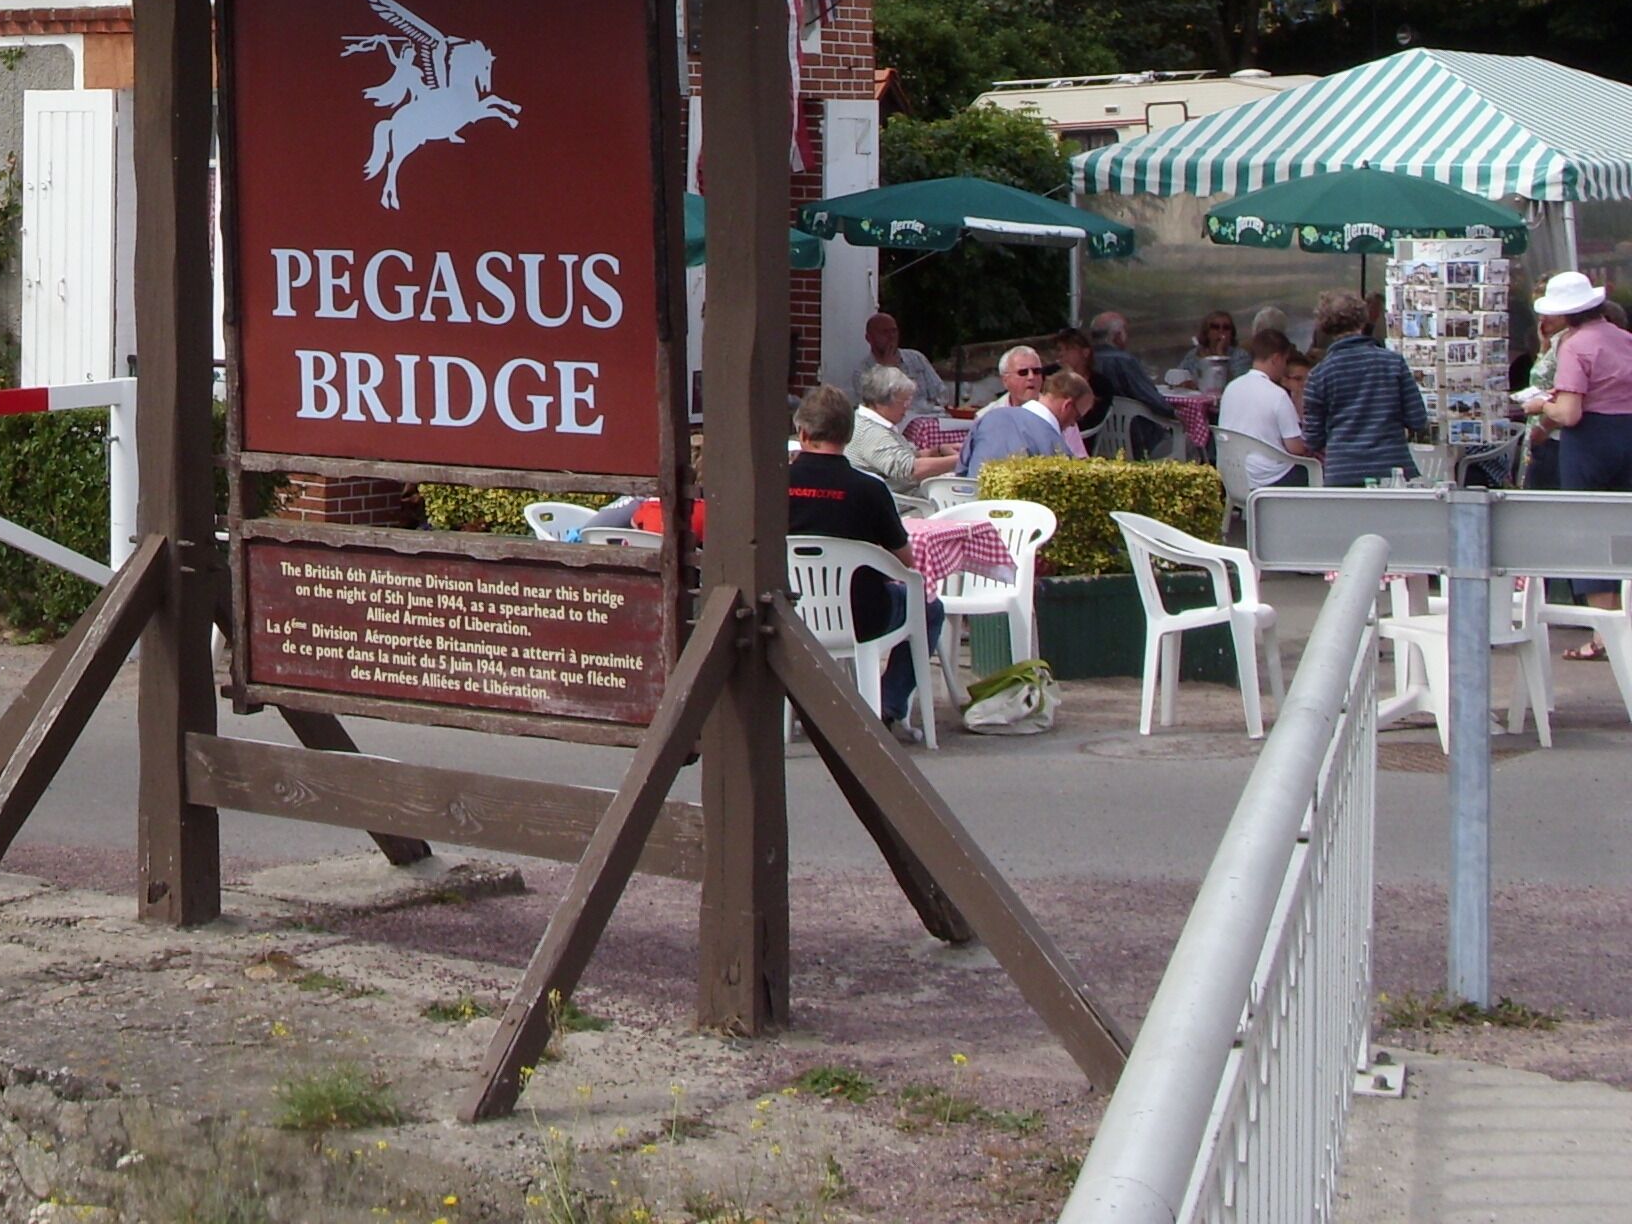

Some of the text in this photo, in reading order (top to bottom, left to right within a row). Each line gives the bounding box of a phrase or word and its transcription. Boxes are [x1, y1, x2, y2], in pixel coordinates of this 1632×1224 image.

[270, 248, 624, 329] PEGASUS
[294, 349, 605, 435] BRIDGE
[280, 562, 624, 609] The British 6th Airborne Division landed near this bridge
[296, 584, 608, 624] on the night of 5th June 1944, as a spearhead to the
[267, 619, 280, 634] La
[312, 623, 358, 642] Division
[365, 628, 433, 650] Aéroportée
[436, 635, 507, 660] Britannique
[511, 647, 519, 658] a
[522, 648, 566, 663] atterri
[569, 649, 577, 664] à
[580, 653, 644, 671] proximité
[366, 607, 532, 637] Allied Armies of Liberation.
[282, 639, 296, 654] de
[300, 644, 312, 656] ce
[316, 645, 344, 661] pont
[347, 646, 375, 662] dans
[378, 649, 389, 664] la
[392, 651, 417, 667] nuit
[420, 653, 436, 668] du
[438, 655, 447, 670] 5
[449, 656, 473, 674] Juin
[477, 658, 507, 678] 1944,
[510, 666, 526, 678] en
[529, 665, 557, 682] tant
[560, 671, 584, 686] que
[351, 665, 551, 700] des Armées Alliées de Libération.
